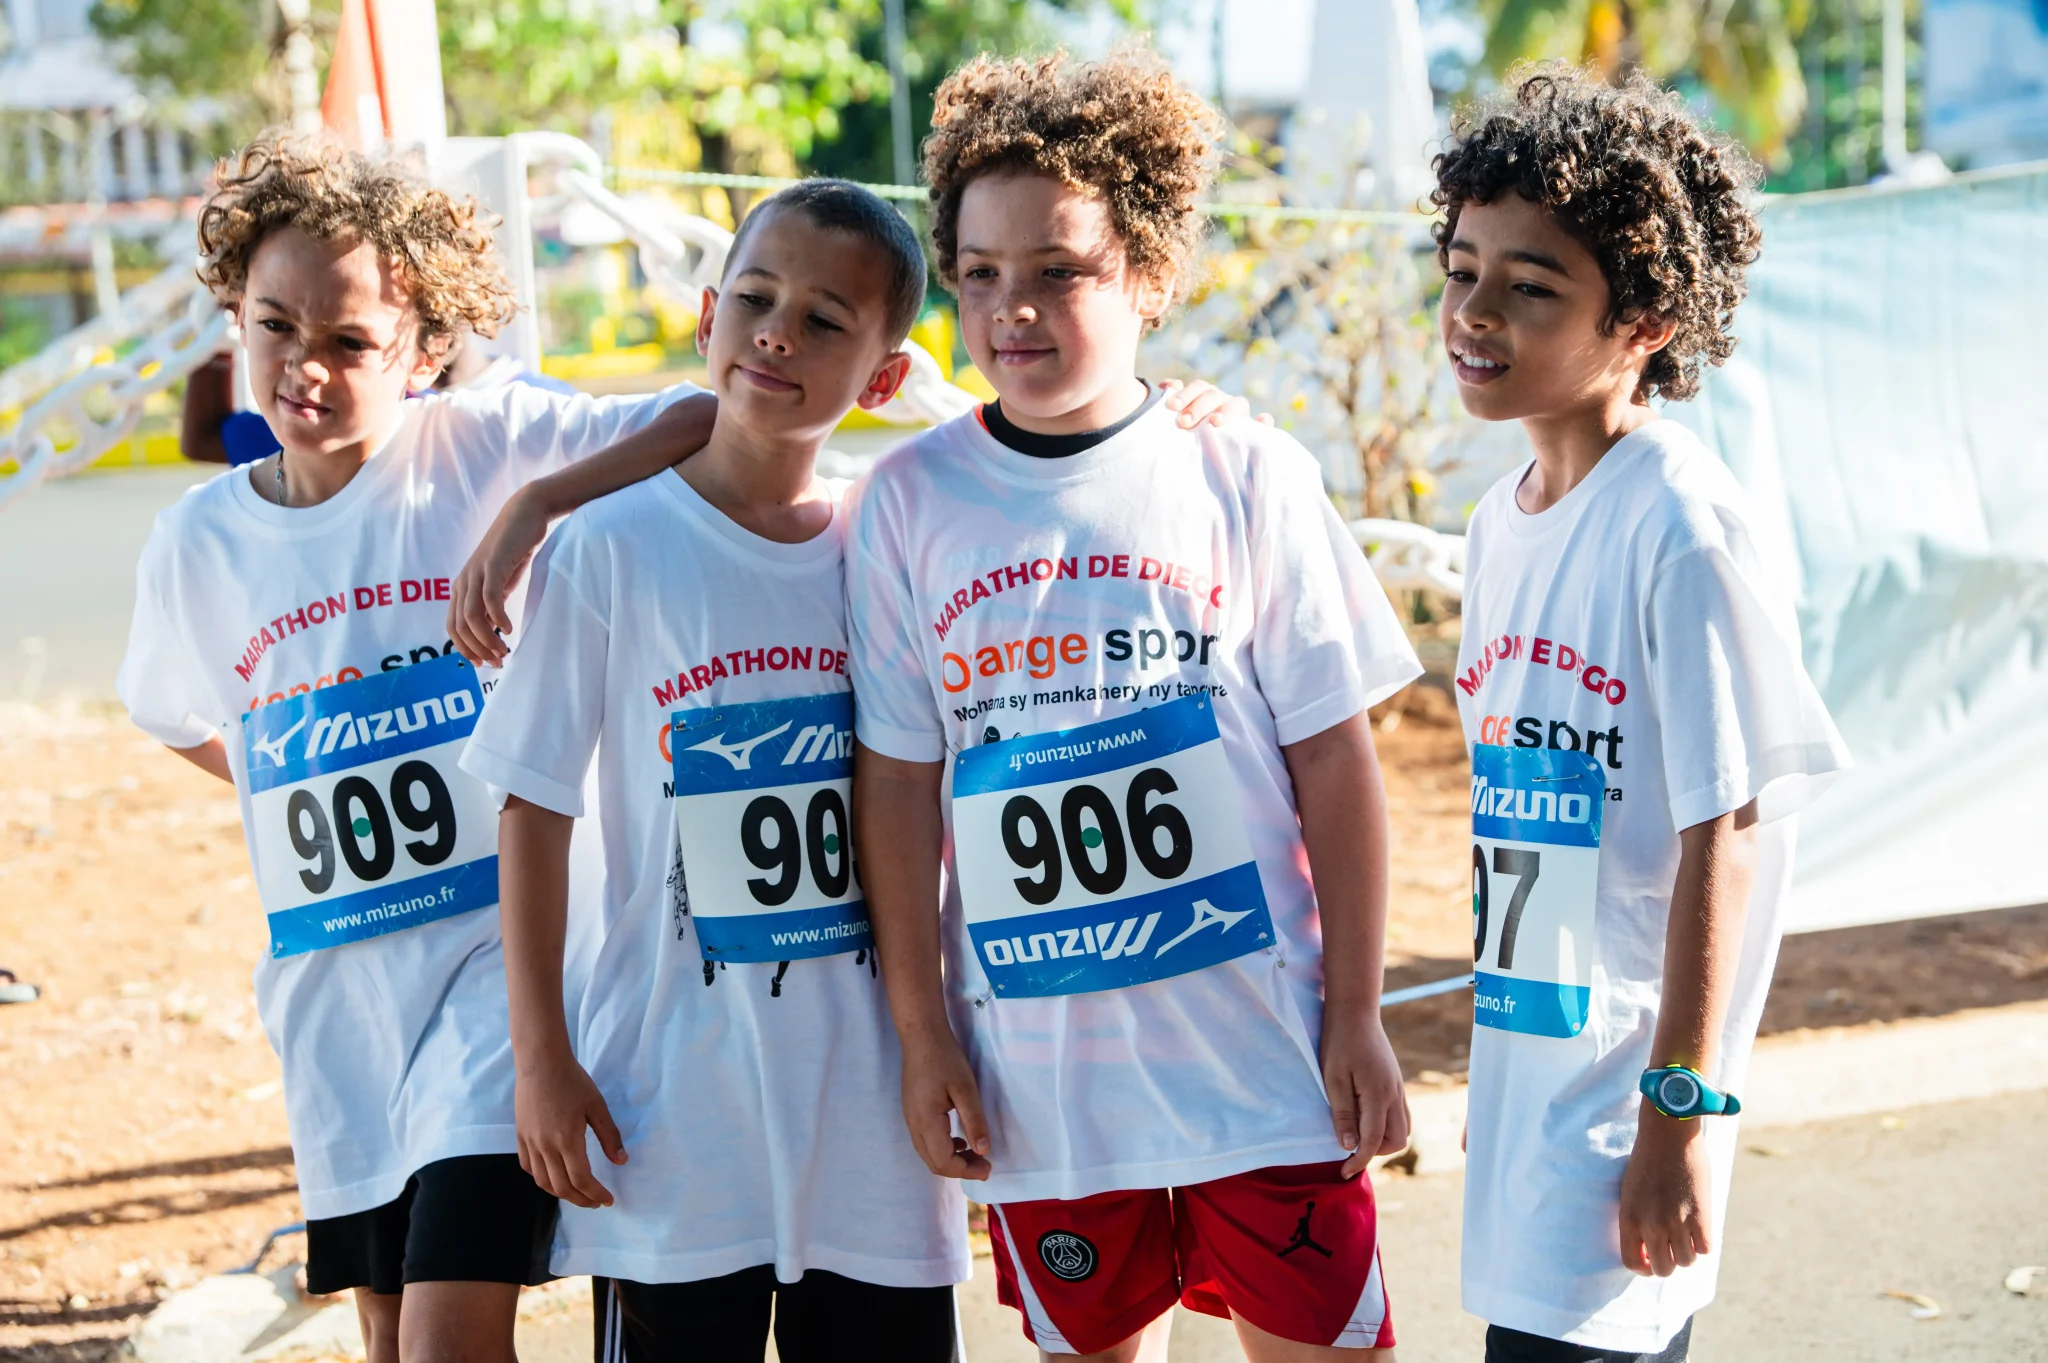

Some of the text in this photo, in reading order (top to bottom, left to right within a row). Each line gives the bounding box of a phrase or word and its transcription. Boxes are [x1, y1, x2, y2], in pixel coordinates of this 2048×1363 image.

[934, 556, 1079, 642] MARATHON
[1087, 554, 1130, 579] DE
[234, 592, 347, 683] MARATHON
[353, 583, 393, 611] DE
[400, 577, 451, 603] DIE
[1105, 629, 1222, 671] spor
[651, 646, 849, 708] MARATHON DE
[1009, 694, 1028, 713] sy
[1033, 681, 1142, 706] mankahery
[1149, 684, 1171, 702] ny
[1009, 728, 1148, 772] www.mizuno.fr
[286, 760, 458, 896] 909
[740, 787, 863, 907] 90
[1001, 767, 1194, 906] 906
[322, 886, 456, 933] www.mizuno.fr
[770, 919, 869, 946] www.mizuno
[1472, 842, 1541, 971] 07
[1474, 993, 1517, 1015] zuno.fr
[1046, 1236, 1077, 1248] PARIS
